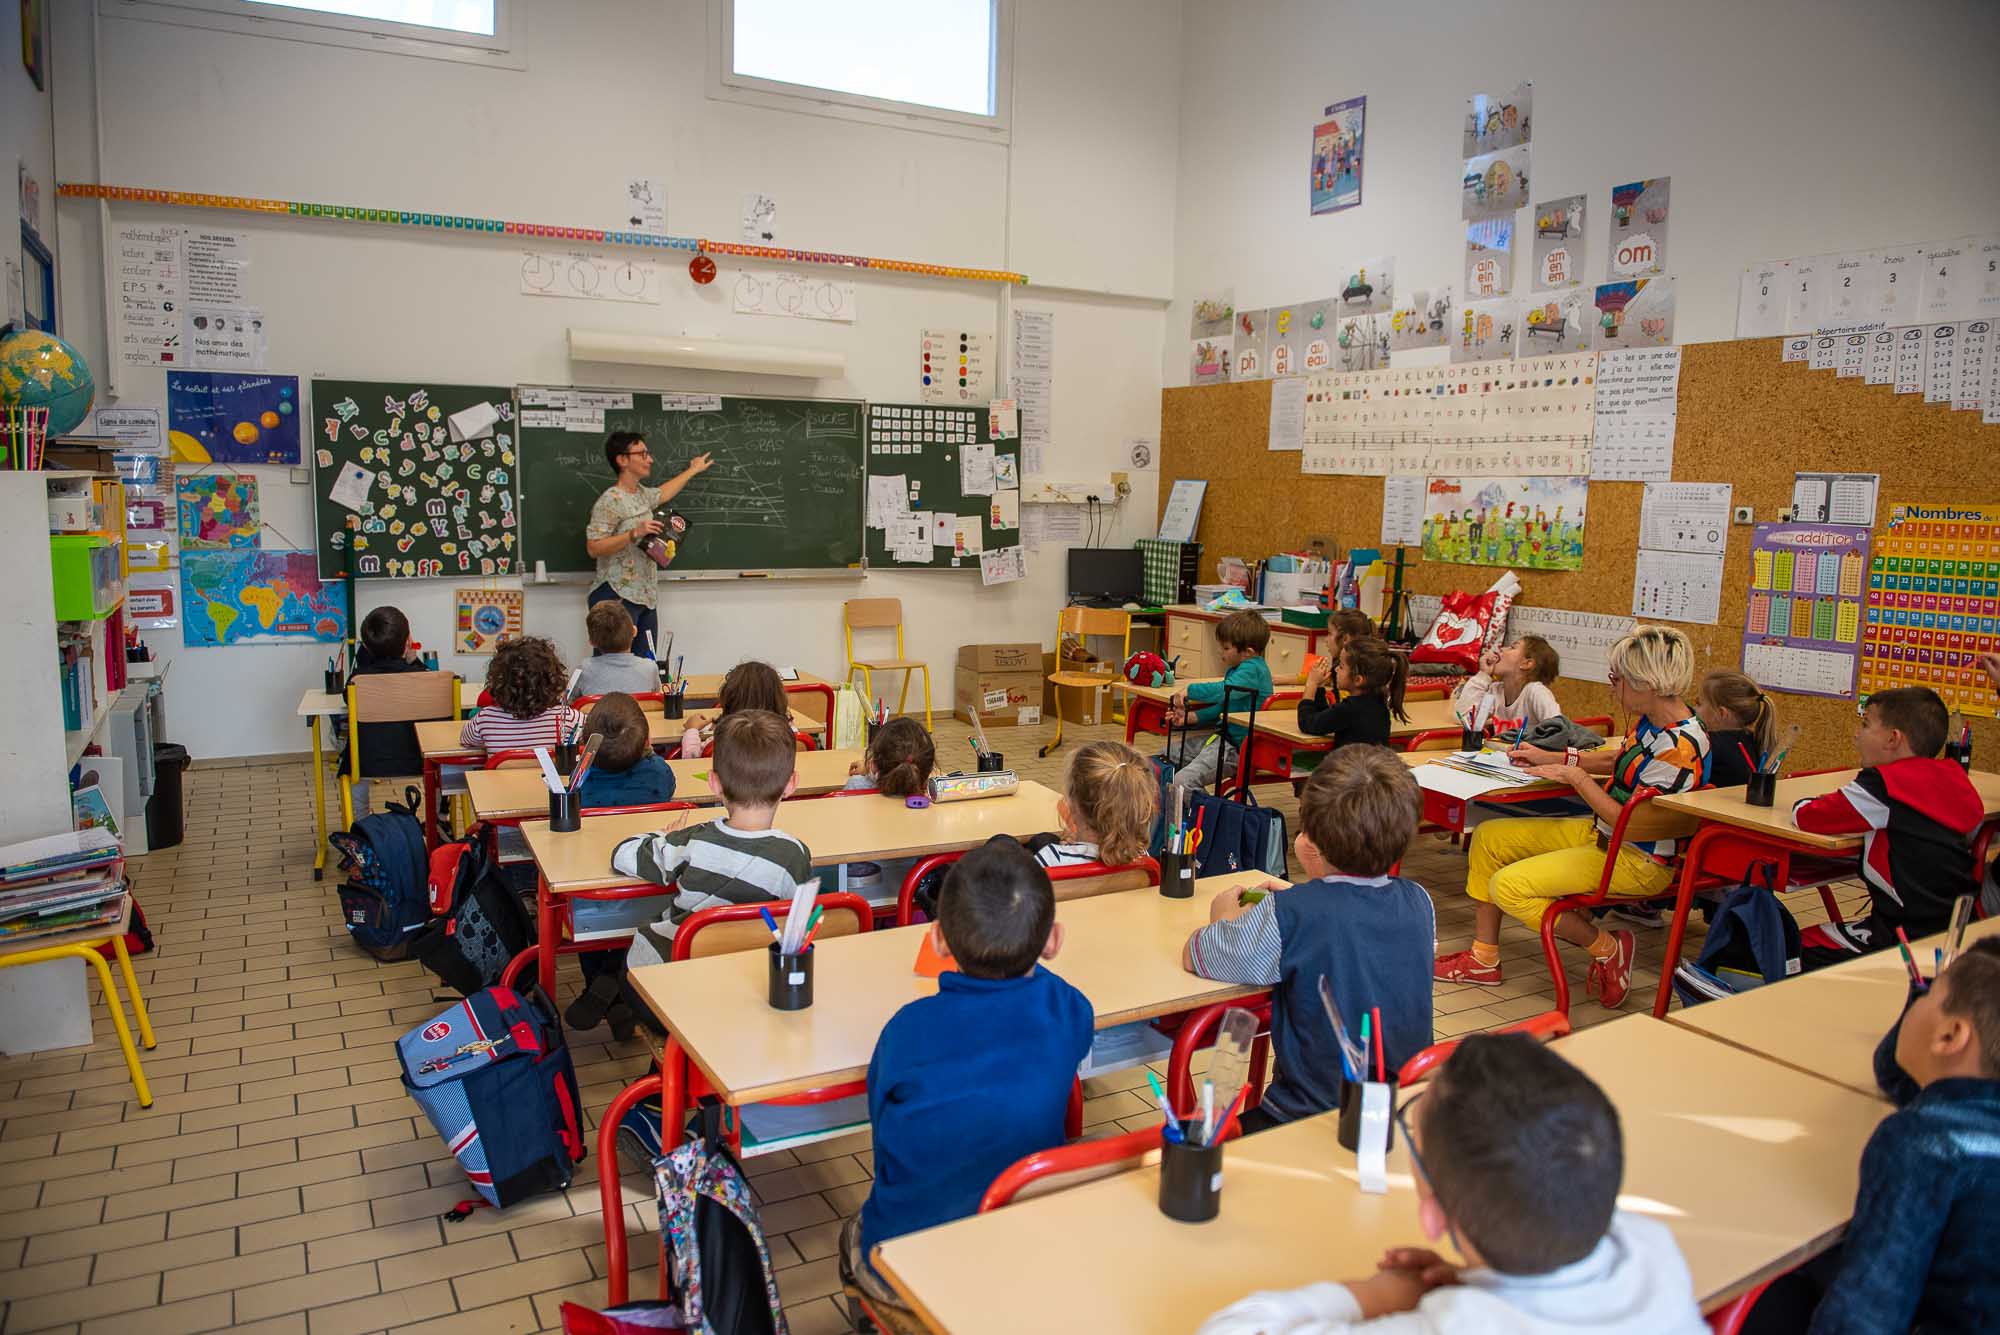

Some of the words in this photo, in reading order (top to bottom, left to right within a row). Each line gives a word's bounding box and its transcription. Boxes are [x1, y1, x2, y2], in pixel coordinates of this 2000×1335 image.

[1548, 252, 1565, 262] am
[1619, 245, 1650, 264] om
[1478, 260, 1494, 272] ain
[1549, 263, 1562, 272] en
[1989, 261, 1996, 271] 5
[1940, 267, 1946, 276] 4
[1478, 272, 1494, 282] ein
[1549, 272, 1564, 282] em
[1844, 277, 1850, 287] 2
[1889, 273, 1896, 283] 3
[1762, 286, 1768, 295] 0
[1802, 282, 1807, 292] 1
[1817, 326, 1856, 336] Répertoire
[1858, 322, 1885, 331] additif
[1310, 342, 1324, 354] au
[1241, 354, 1256, 375] ph
[1307, 354, 1327, 367] eau
[1906, 506, 1982, 520] Nombres
